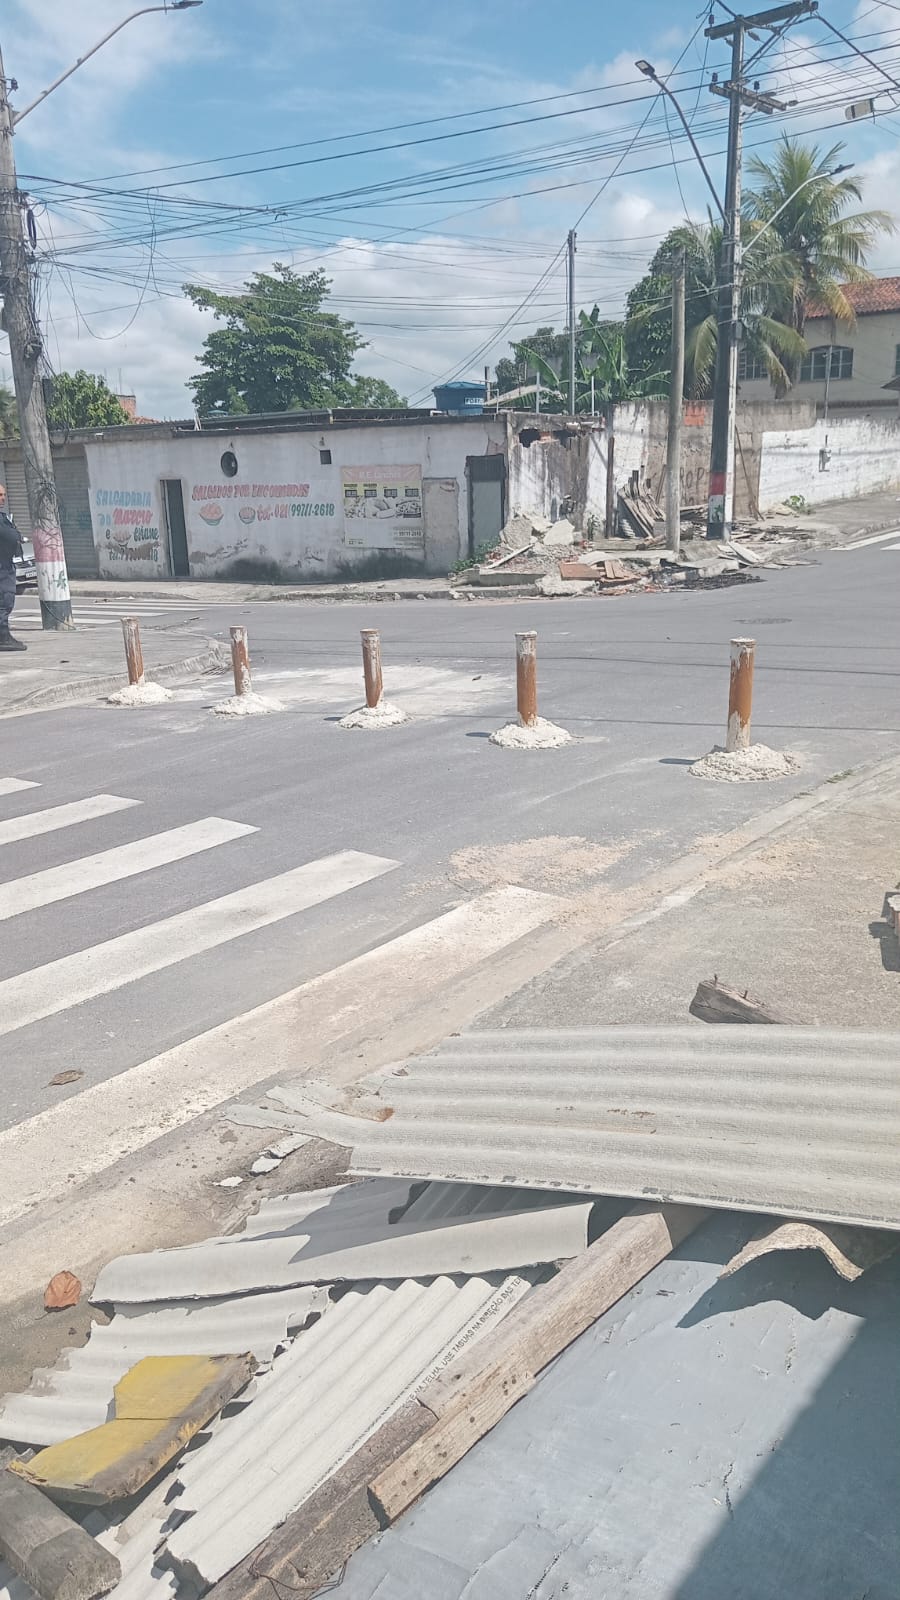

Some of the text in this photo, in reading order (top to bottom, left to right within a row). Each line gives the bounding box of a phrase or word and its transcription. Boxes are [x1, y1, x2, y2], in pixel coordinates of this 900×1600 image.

[96, 489, 152, 508] SALGADARIA
[441, 1350, 455, 1366] USE
[471, 1321, 483, 1334] NA
[500, 1286, 514, 1300] DAS
